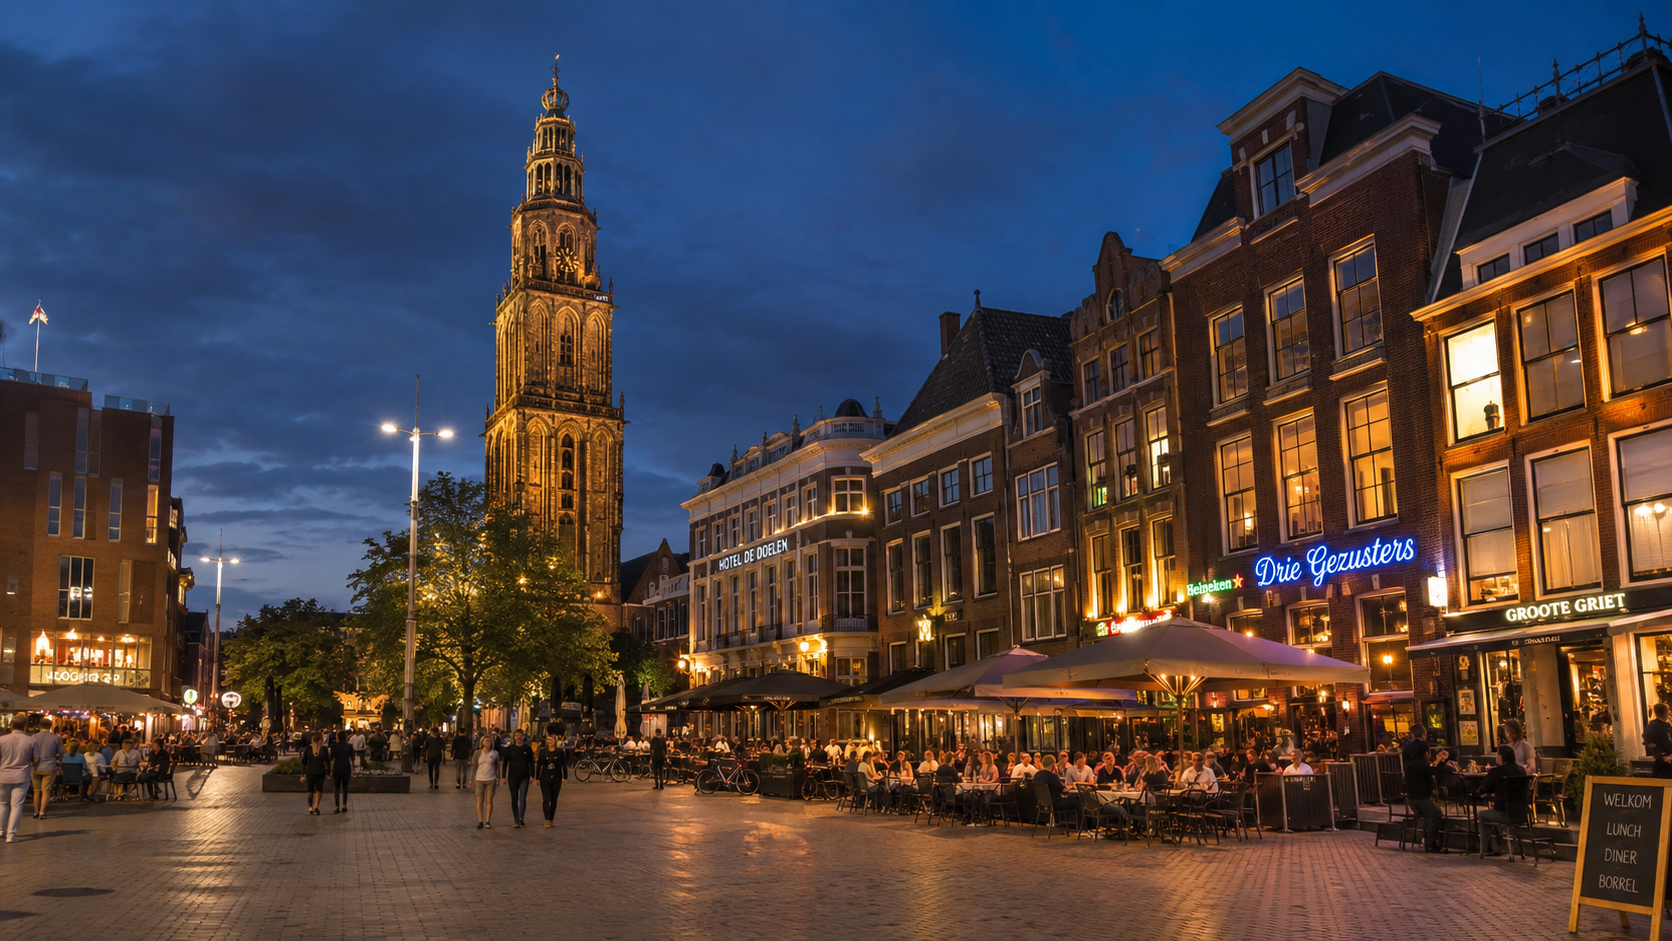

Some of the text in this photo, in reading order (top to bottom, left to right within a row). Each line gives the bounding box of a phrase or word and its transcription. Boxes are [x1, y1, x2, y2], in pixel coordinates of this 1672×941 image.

[719, 538, 788, 571] HOTEL DE DOELEN
[1255, 537, 1415, 587] Drie Gezusters
[1186, 579, 1232, 597] Heineken
[1505, 593, 1626, 622] GROOTE GRIET
[1603, 792, 1652, 810] WELKOM
[1606, 821, 1642, 838] LUNCH
[1604, 848, 1638, 865] DINER
[1598, 874, 1639, 893] BORREL
